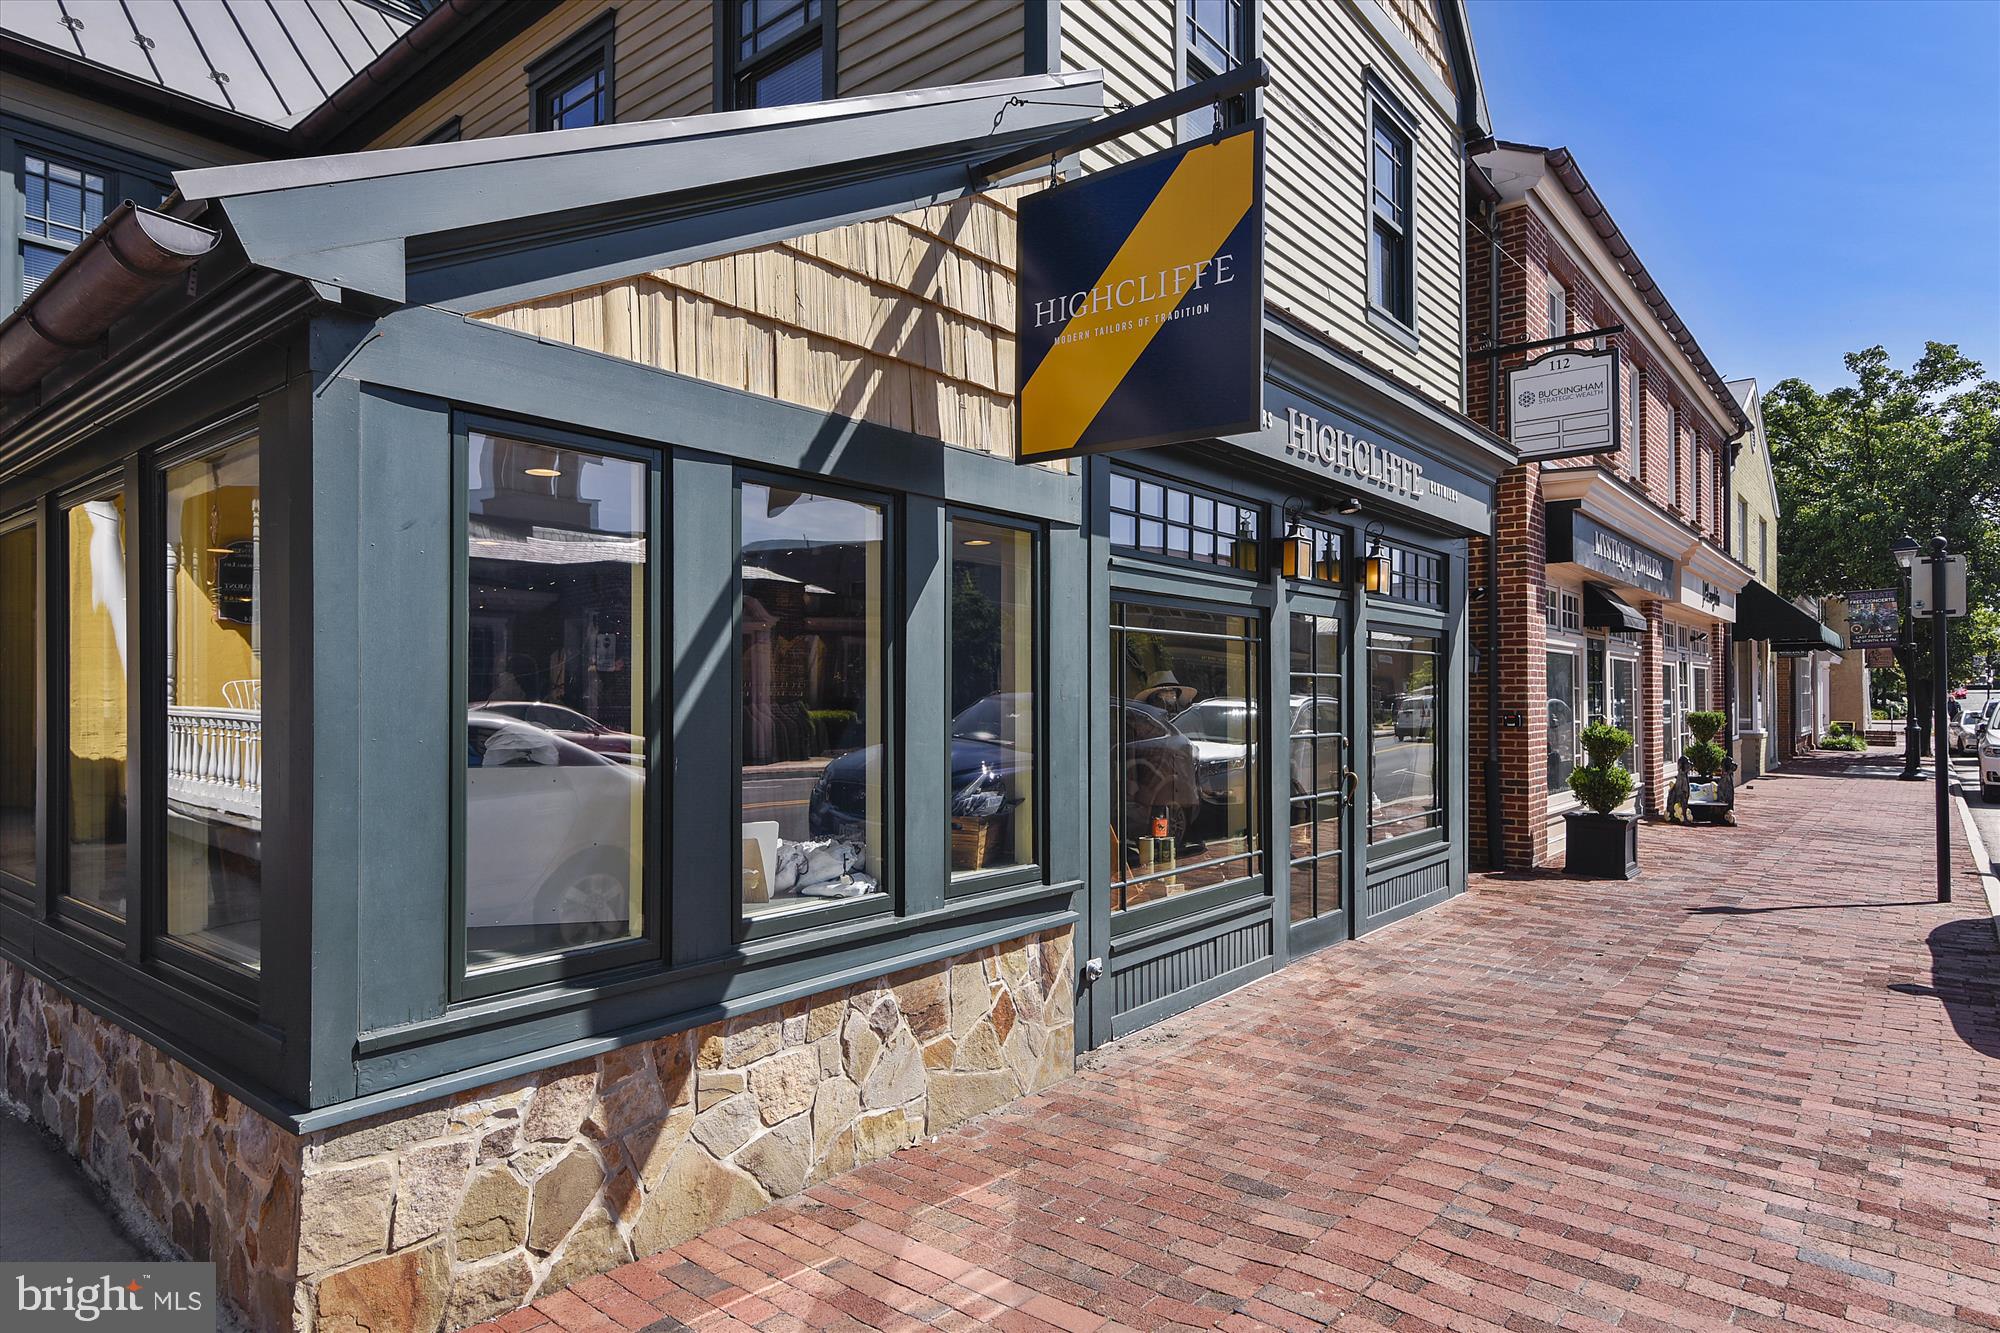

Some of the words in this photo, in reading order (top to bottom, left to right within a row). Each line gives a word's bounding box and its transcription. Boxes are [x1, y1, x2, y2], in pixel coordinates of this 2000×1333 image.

[1034, 254, 1236, 328] HIGHCLIFFE
[1054, 329, 1090, 345] MODERN
[1095, 320, 1133, 337] TAILORS
[1138, 316, 1150, 328] OF
[1155, 303, 1210, 324] TRADITION
[1549, 358, 1571, 371] 112
[1538, 381, 1604, 398] BUCKINGHAM
[1538, 394, 1574, 405] STRATEGIC
[1575, 389, 1604, 399] WEALTH
[1286, 407, 1424, 496] HIGHCLIFFE
[1593, 530, 1632, 572] MYSTIQUE
